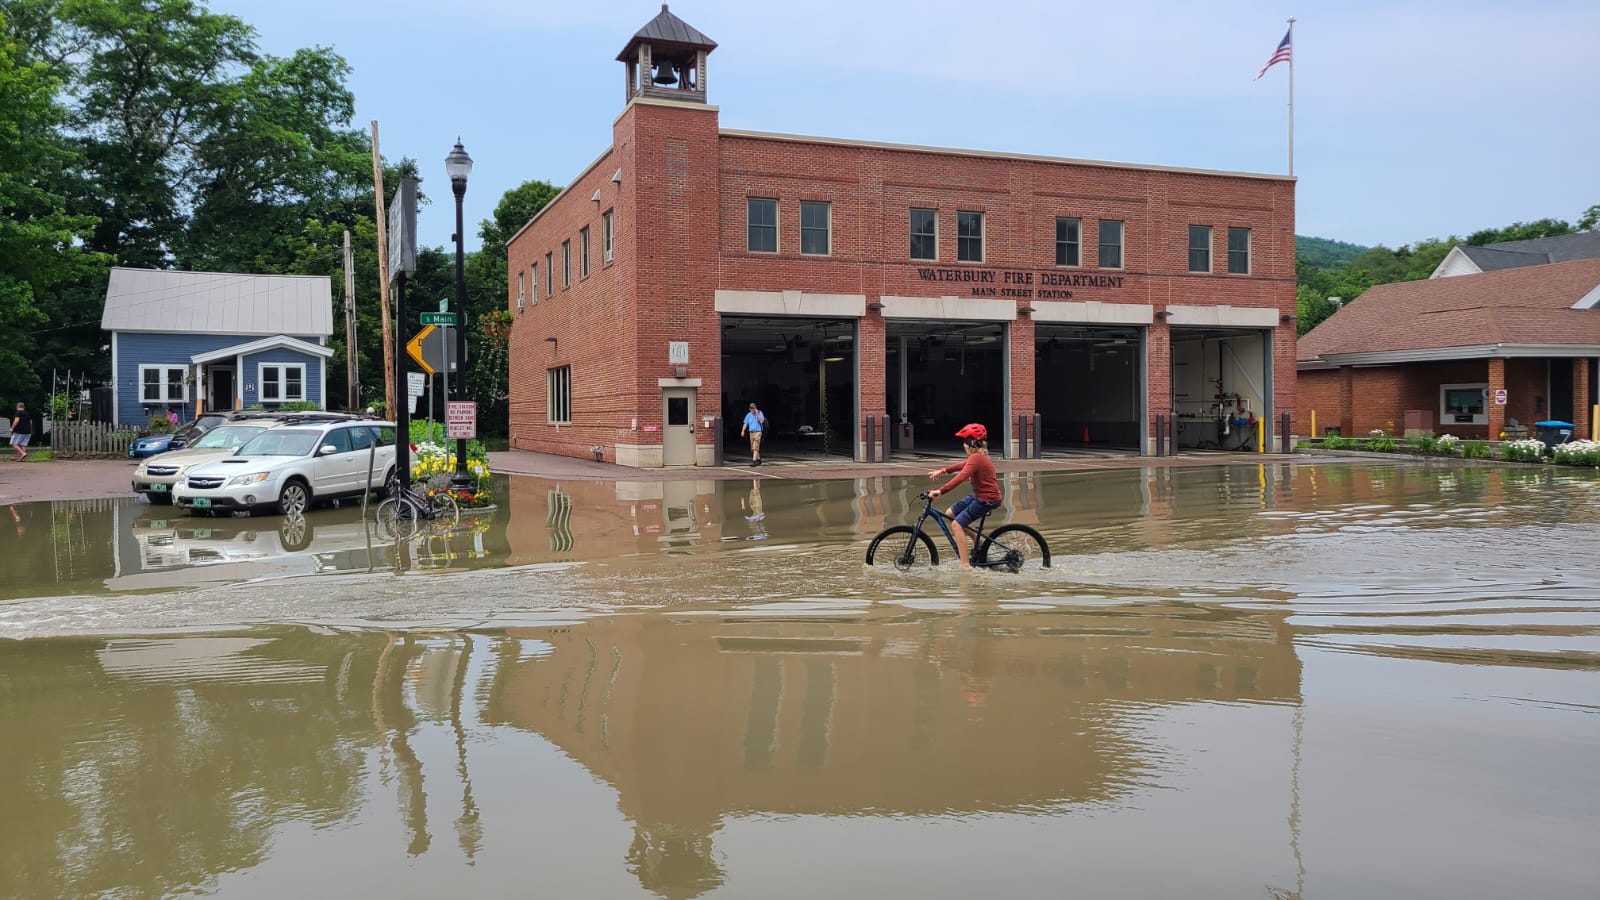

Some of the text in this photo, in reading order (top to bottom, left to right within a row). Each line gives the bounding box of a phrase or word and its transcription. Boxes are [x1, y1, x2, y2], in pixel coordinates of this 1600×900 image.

[918, 268, 1124, 288] WATERBURY FIRE DEPARTMENT
[972, 287, 1073, 298] MAIN STREET STATION
[433, 315, 452, 323] Main
